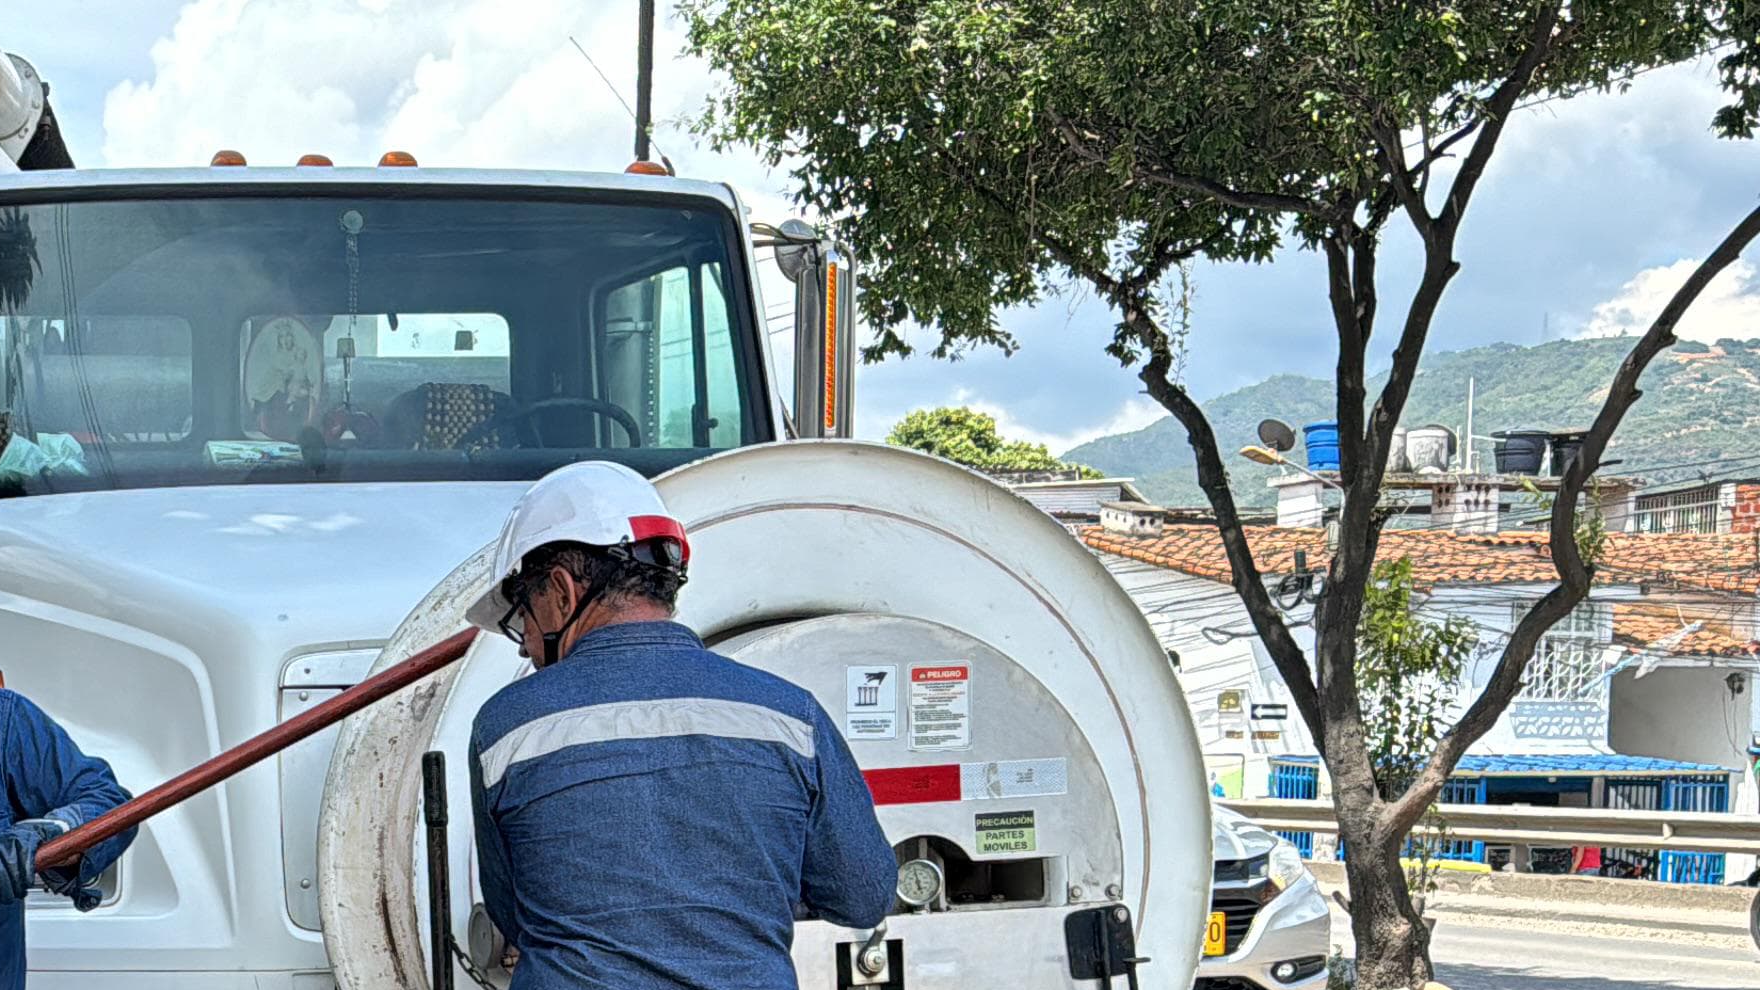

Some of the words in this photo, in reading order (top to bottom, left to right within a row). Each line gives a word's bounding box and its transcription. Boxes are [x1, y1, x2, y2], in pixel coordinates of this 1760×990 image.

[927, 670, 962, 679] PELIGRO
[976, 816, 1033, 827] PRECAUCIÓN
[985, 831, 1025, 841] PARTES
[984, 841, 1028, 852] MOVILES
